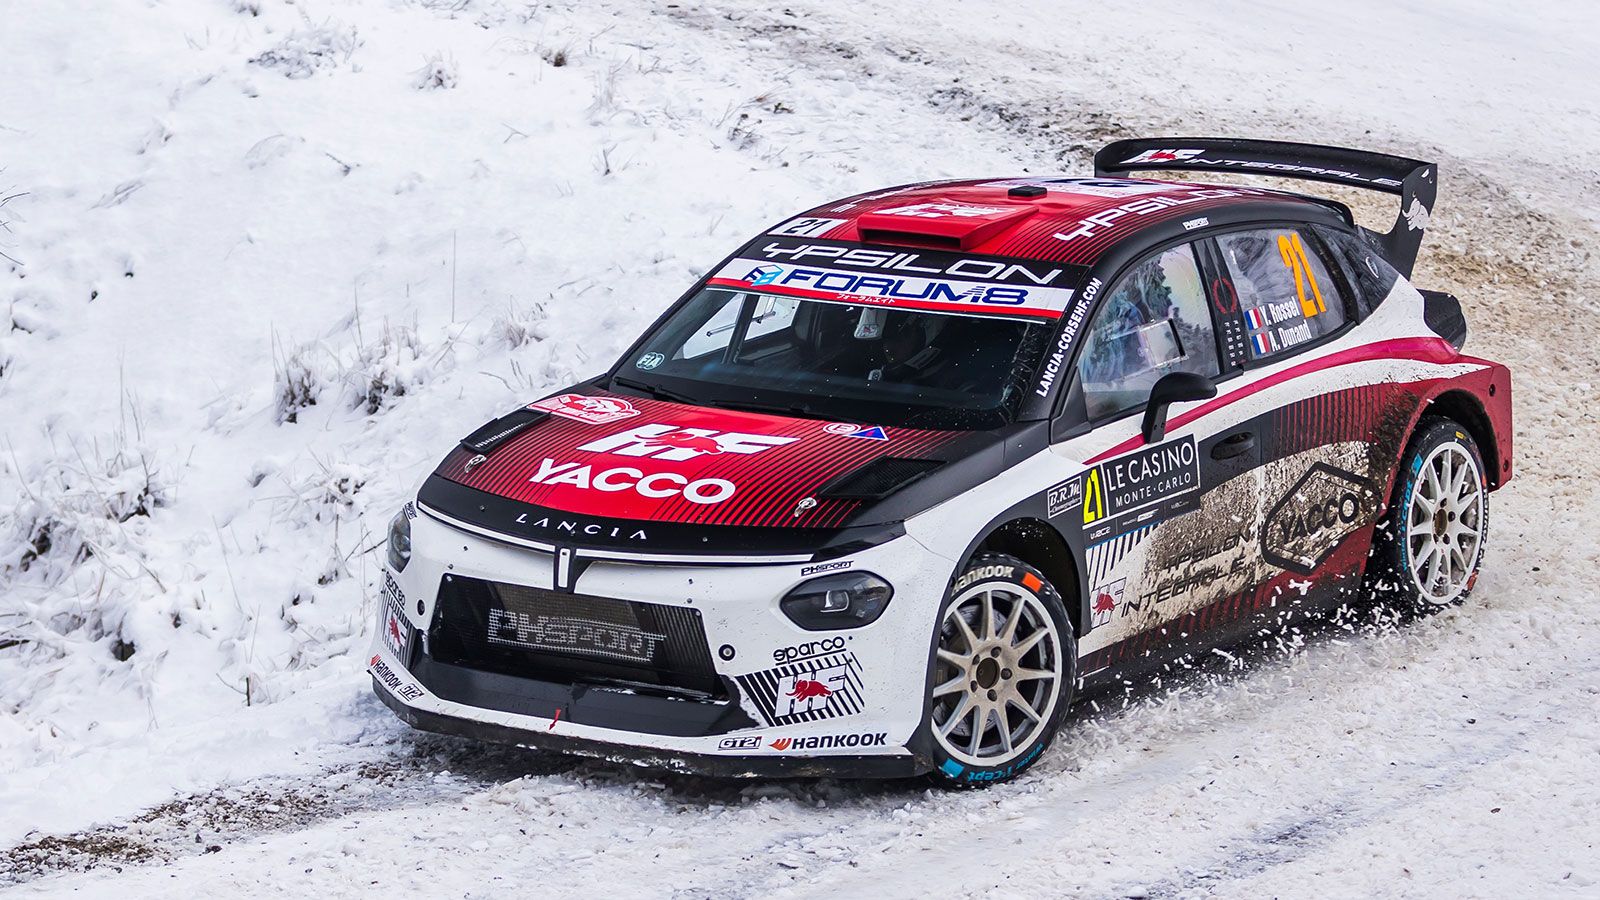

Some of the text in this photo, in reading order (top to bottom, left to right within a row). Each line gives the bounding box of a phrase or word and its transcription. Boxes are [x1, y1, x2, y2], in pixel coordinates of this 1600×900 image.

[1185, 158, 1403, 186] INTEGRALE
[783, 218, 831, 236] 21
[762, 242, 1062, 285] YPSILON
[1277, 232, 1327, 318] 21
[780, 268, 1028, 305] FORUM8
[836, 292, 896, 304] フォーラムエイト
[1268, 296, 1300, 324] Rossel
[1035, 277, 1103, 398] LANCIA-CORSEHF.COM
[1268, 330, 1281, 352] A.
[1278, 319, 1312, 348] Dunand
[529, 458, 736, 504] YACCO
[1107, 442, 1194, 491] LE CASINO
[515, 513, 647, 540] LANCIA
[773, 636, 845, 664] sparco
